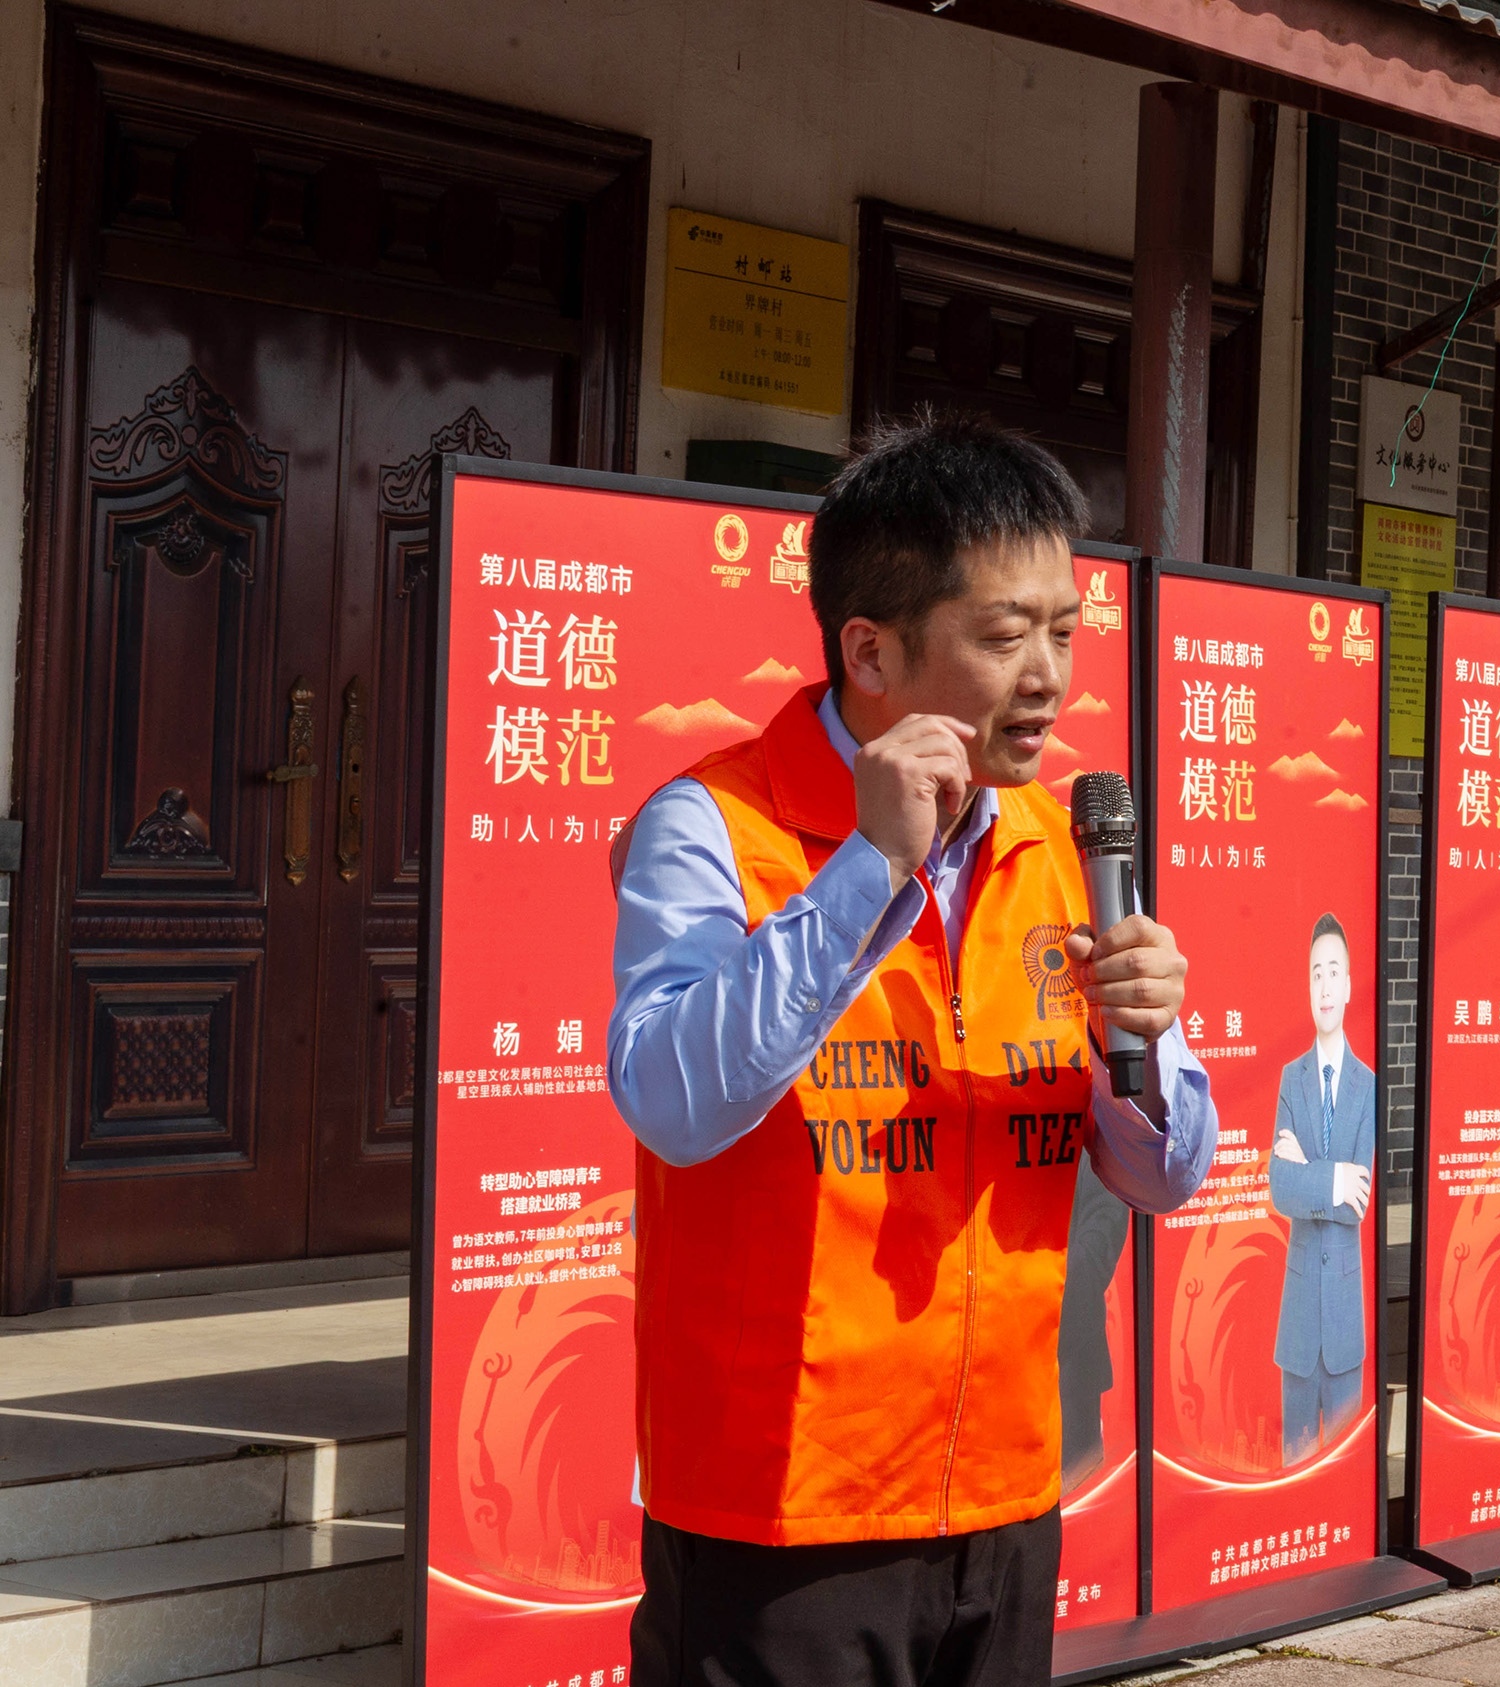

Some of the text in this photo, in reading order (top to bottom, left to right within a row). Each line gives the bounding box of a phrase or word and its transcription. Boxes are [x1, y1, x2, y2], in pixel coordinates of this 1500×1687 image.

[735, 255, 792, 282] 村邮站
[745, 293, 783, 317] 界牌村
[1376, 444, 1450, 480] 文化服务中心
[479, 553, 633, 595] 第八届成都市
[711, 565, 751, 577] CHENGDU
[488, 608, 619, 691] 道德
[1173, 635, 1264, 669] 第八届成都市
[1179, 680, 1257, 745] 道德
[485, 705, 616, 786] 模范
[1178, 757, 1257, 822] 模范
[437, 1064, 608, 1084] 都星空里文化发展有限公司社会企
[810, 1039, 1058, 1089] CHENG DU
[457, 1079, 610, 1099] 星空里残疾人辅助性就业基地负
[804, 1117, 937, 1175] VOLUN
[480, 1166, 602, 1193] 转型助心智障碍青年
[501, 1192, 581, 1216] 搭建就业桥梁
[1211, 1522, 1328, 1564] 中共成都市委宣传部
[1333, 1526, 1351, 1543] 发布
[1210, 1541, 1327, 1585] 成都市精神文明建设办公室
[1077, 1584, 1102, 1603] 发布
